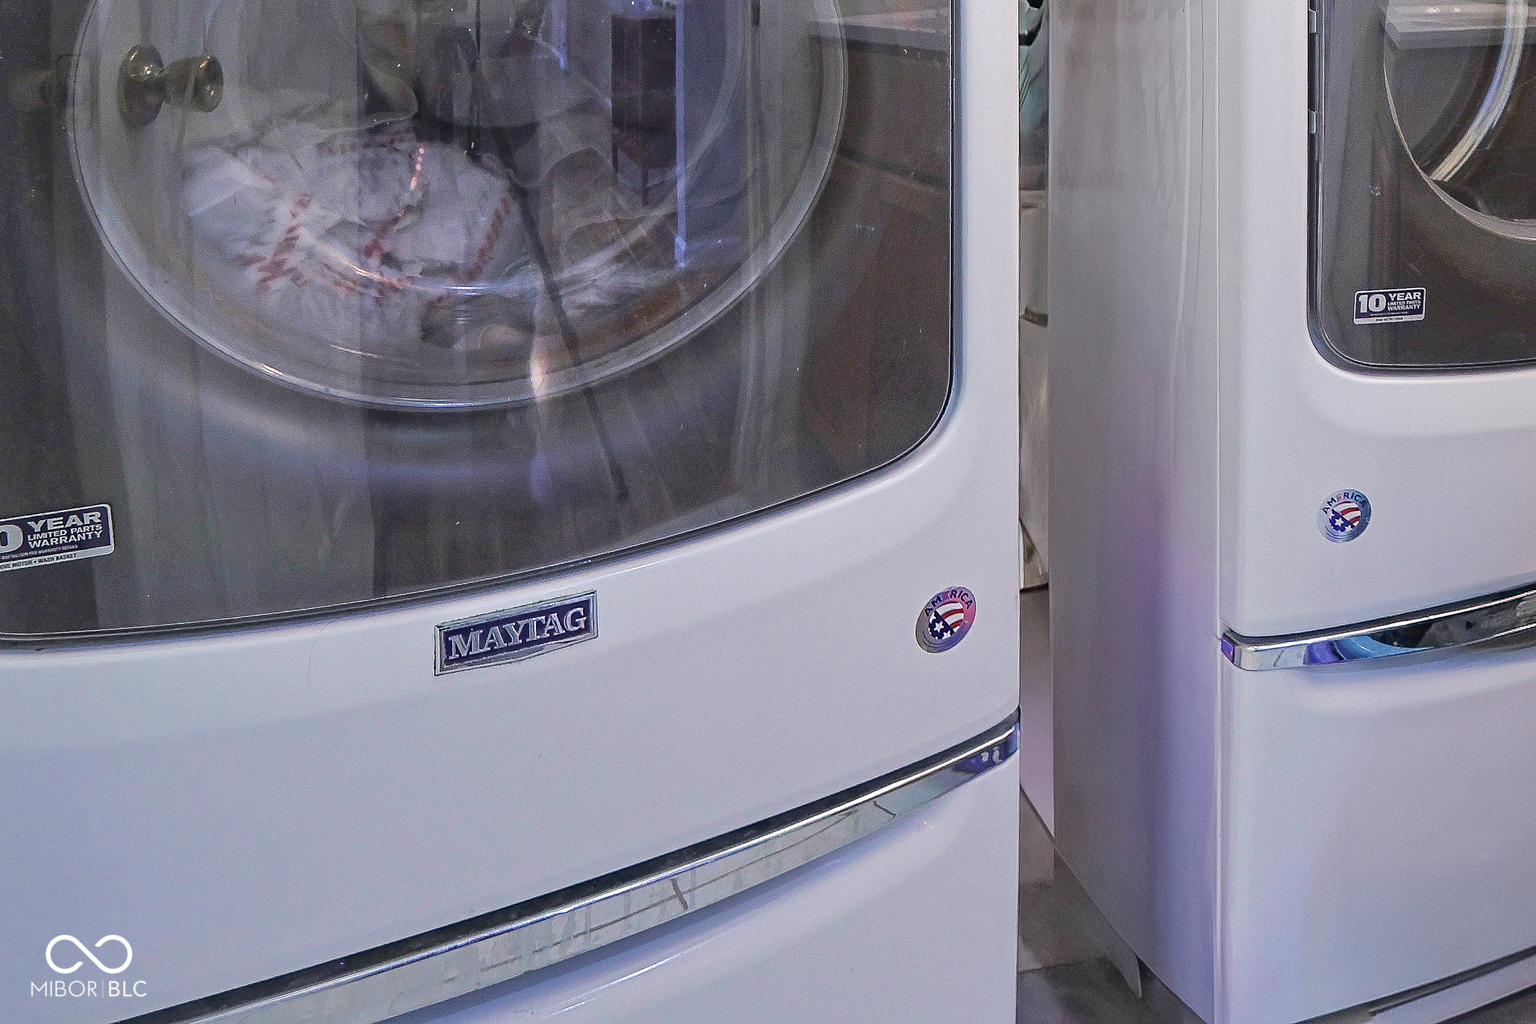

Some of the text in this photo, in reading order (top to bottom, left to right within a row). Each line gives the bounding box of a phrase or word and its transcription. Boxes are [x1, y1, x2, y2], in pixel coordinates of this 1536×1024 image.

[1359, 292, 1421, 313] 10 YEAR
[0, 512, 101, 553] 0 YEAR
[28, 524, 102, 540] LIMITED PARTS
[29, 530, 102, 549] WARRANTY
[925, 590, 973, 617] AMRICA
[448, 607, 587, 660] MAYTAG
